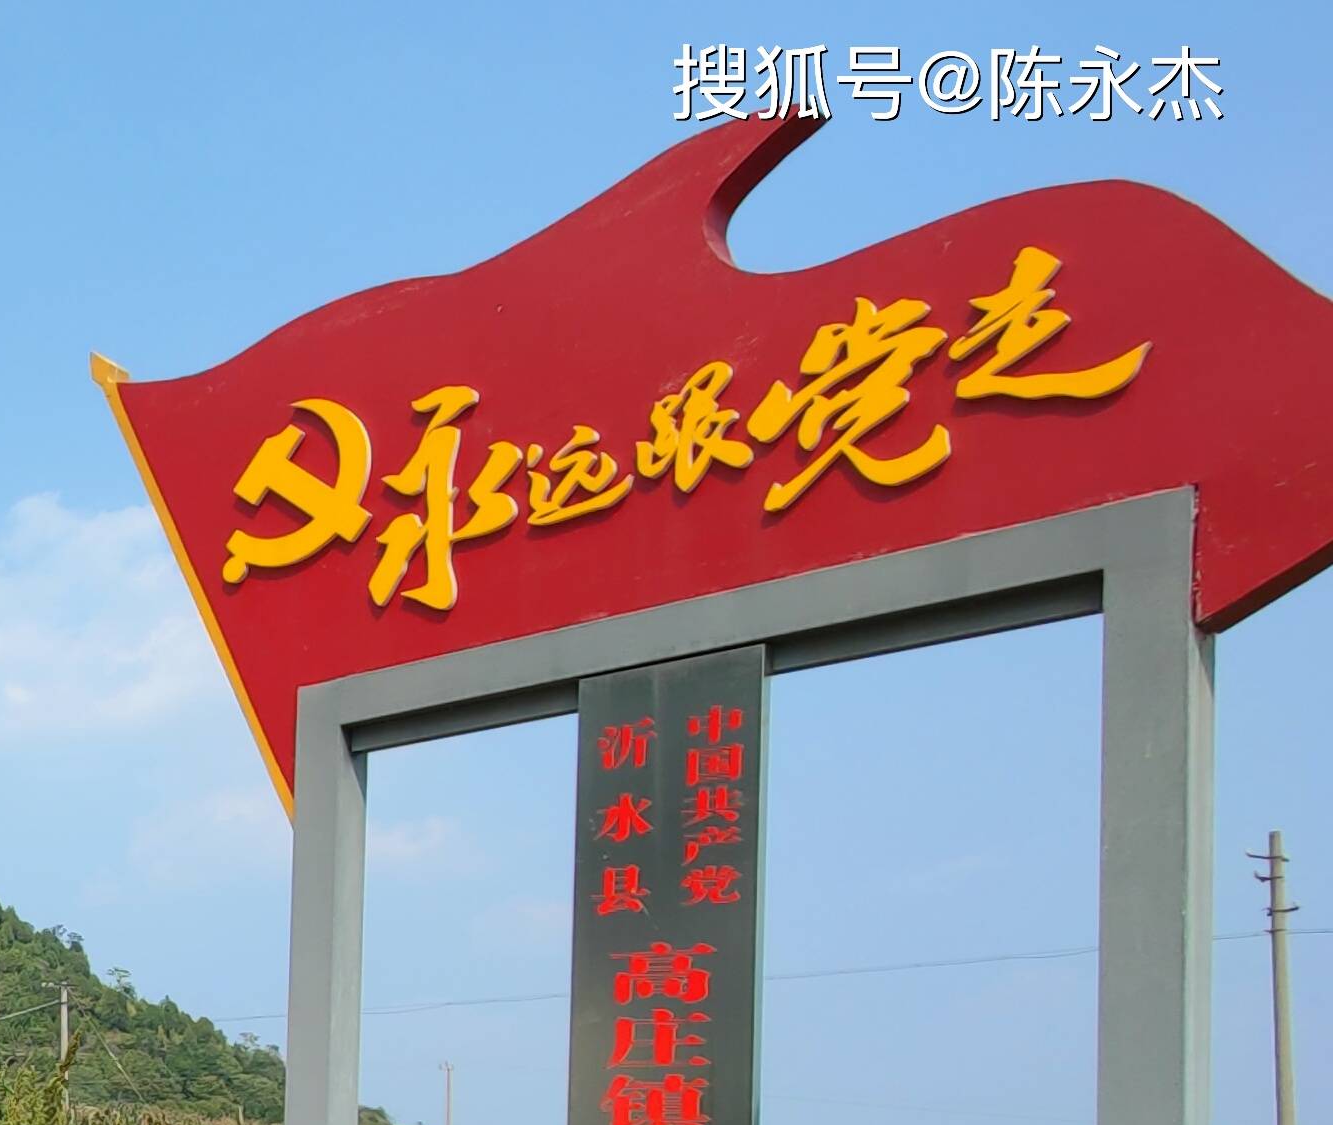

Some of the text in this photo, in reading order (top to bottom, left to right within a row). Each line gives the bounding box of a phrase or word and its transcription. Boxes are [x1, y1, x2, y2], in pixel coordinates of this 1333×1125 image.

[370, 246, 1153, 611] 永远跟党走
[590, 716, 658, 917] 沂水县
[682, 704, 745, 905] 中国共产党
